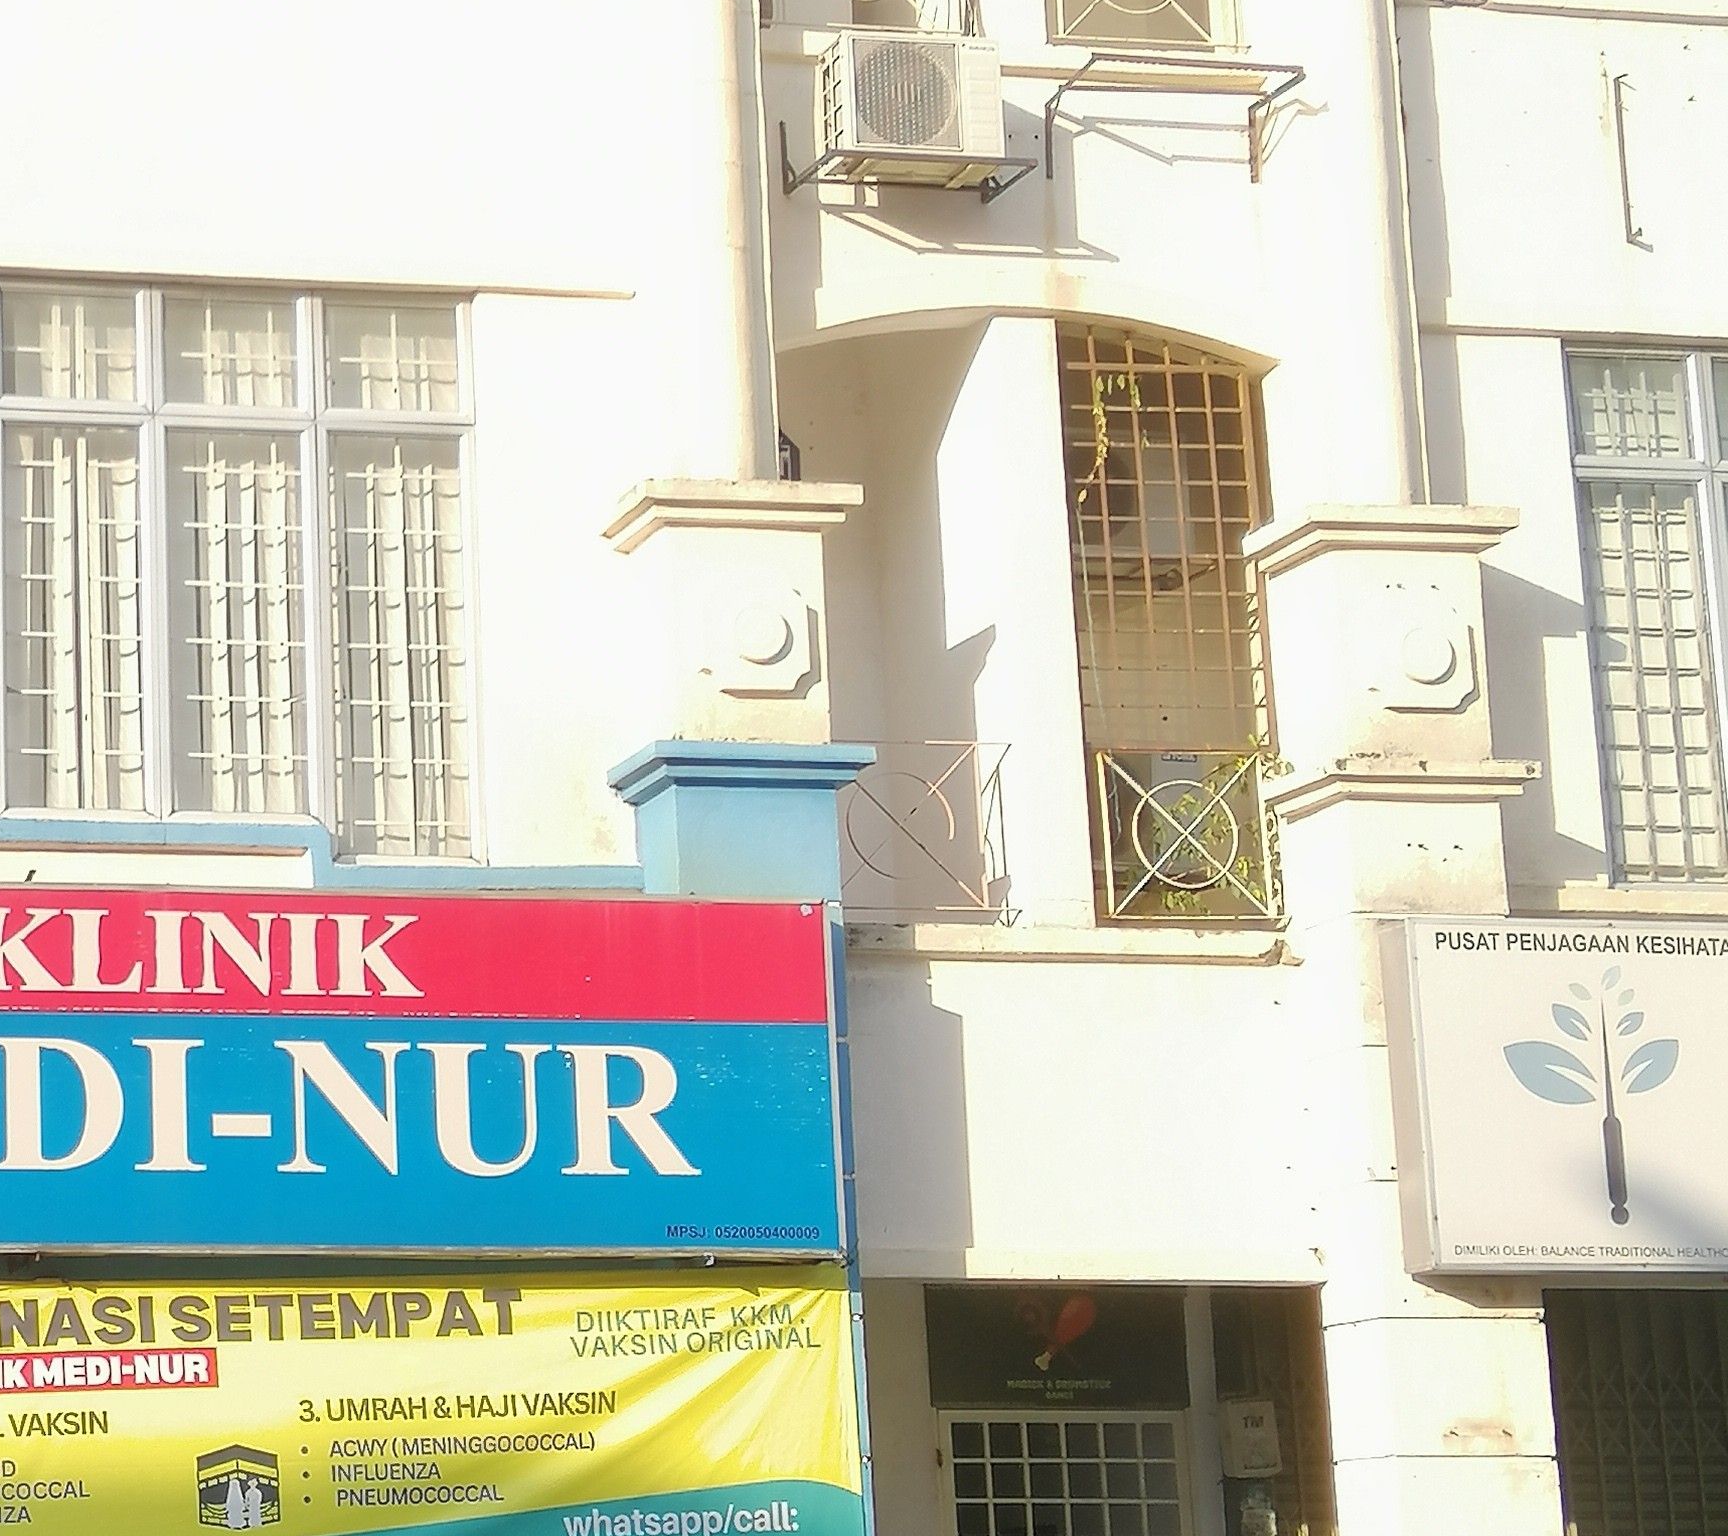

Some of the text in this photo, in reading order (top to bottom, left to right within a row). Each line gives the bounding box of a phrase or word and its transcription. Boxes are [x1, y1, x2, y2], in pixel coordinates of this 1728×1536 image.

[1434, 931, 1728, 956] PUSAT PENJAGAAN KESIHATA
[715, 1225, 820, 1241] 0520050400009
[1454, 1244, 1501, 1257] DIMILIKI
[1540, 1245, 1595, 1257] BALANCE
[1599, 1246, 1674, 1258] TRADITIONAL
[170, 1288, 523, 1344] SETEMPAT
[570, 1326, 822, 1358] VAKSIN ORIGINAL
[32, 1352, 210, 1388] MEDI-NUR
[325, 1396, 426, 1423] UMRAH
[432, 1395, 452, 1419] &
[456, 1393, 517, 1419] HAJI
[521, 1390, 617, 1417] VAKSIN
[8, 1410, 109, 1438] VAKSIN
[329, 1438, 388, 1458] ACWY
[330, 1462, 442, 1483] INFLUENZA
[336, 1483, 505, 1508] PNEUMOCOCCAL
